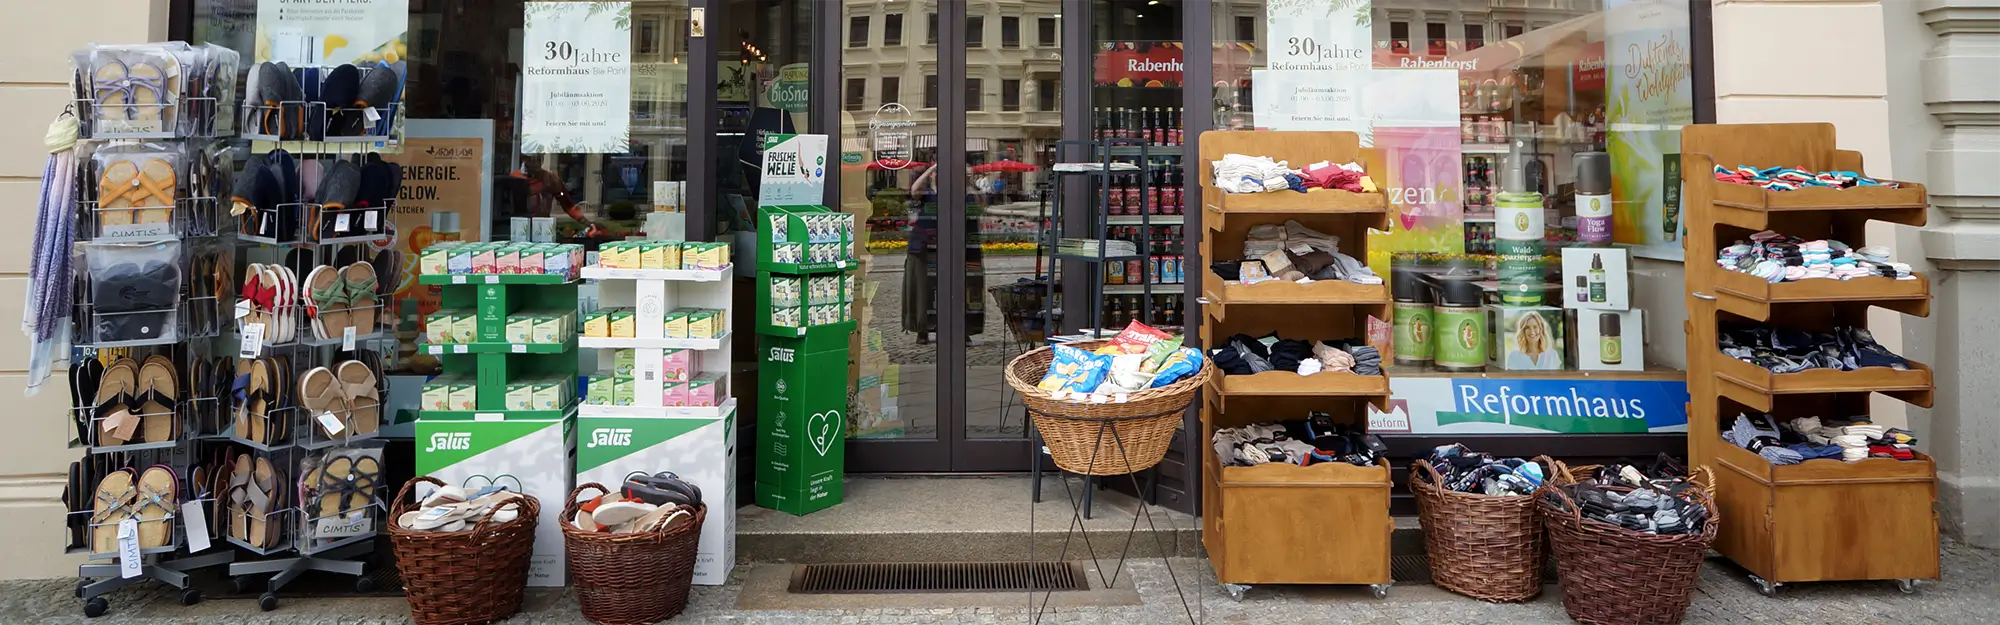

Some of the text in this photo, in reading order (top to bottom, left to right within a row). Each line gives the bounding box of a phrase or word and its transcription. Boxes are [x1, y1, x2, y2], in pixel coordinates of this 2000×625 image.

[544, 40, 621, 67] 30 Jahre
[1287, 36, 1363, 63] 30 Jahre
[527, 64, 590, 76] Reformhaus
[1271, 61, 1333, 71] Reformhaus
[1400, 56, 1479, 70] Rabenhorst
[768, 151, 797, 162] FRISCHE
[400, 165, 461, 181] ENERGIE.
[766, 162, 796, 176] WELLE
[399, 185, 440, 201] GLOW.
[1586, 218, 1605, 227] Yoga
[1511, 246, 1534, 254] Wald-
[767, 346, 796, 363] Salus
[1458, 384, 1647, 425] Reformhaus
[425, 431, 473, 453] Salus
[586, 427, 634, 449] Salus
[323, 524, 361, 534] CIMTIS
[126, 528, 139, 570] CIMTIS
